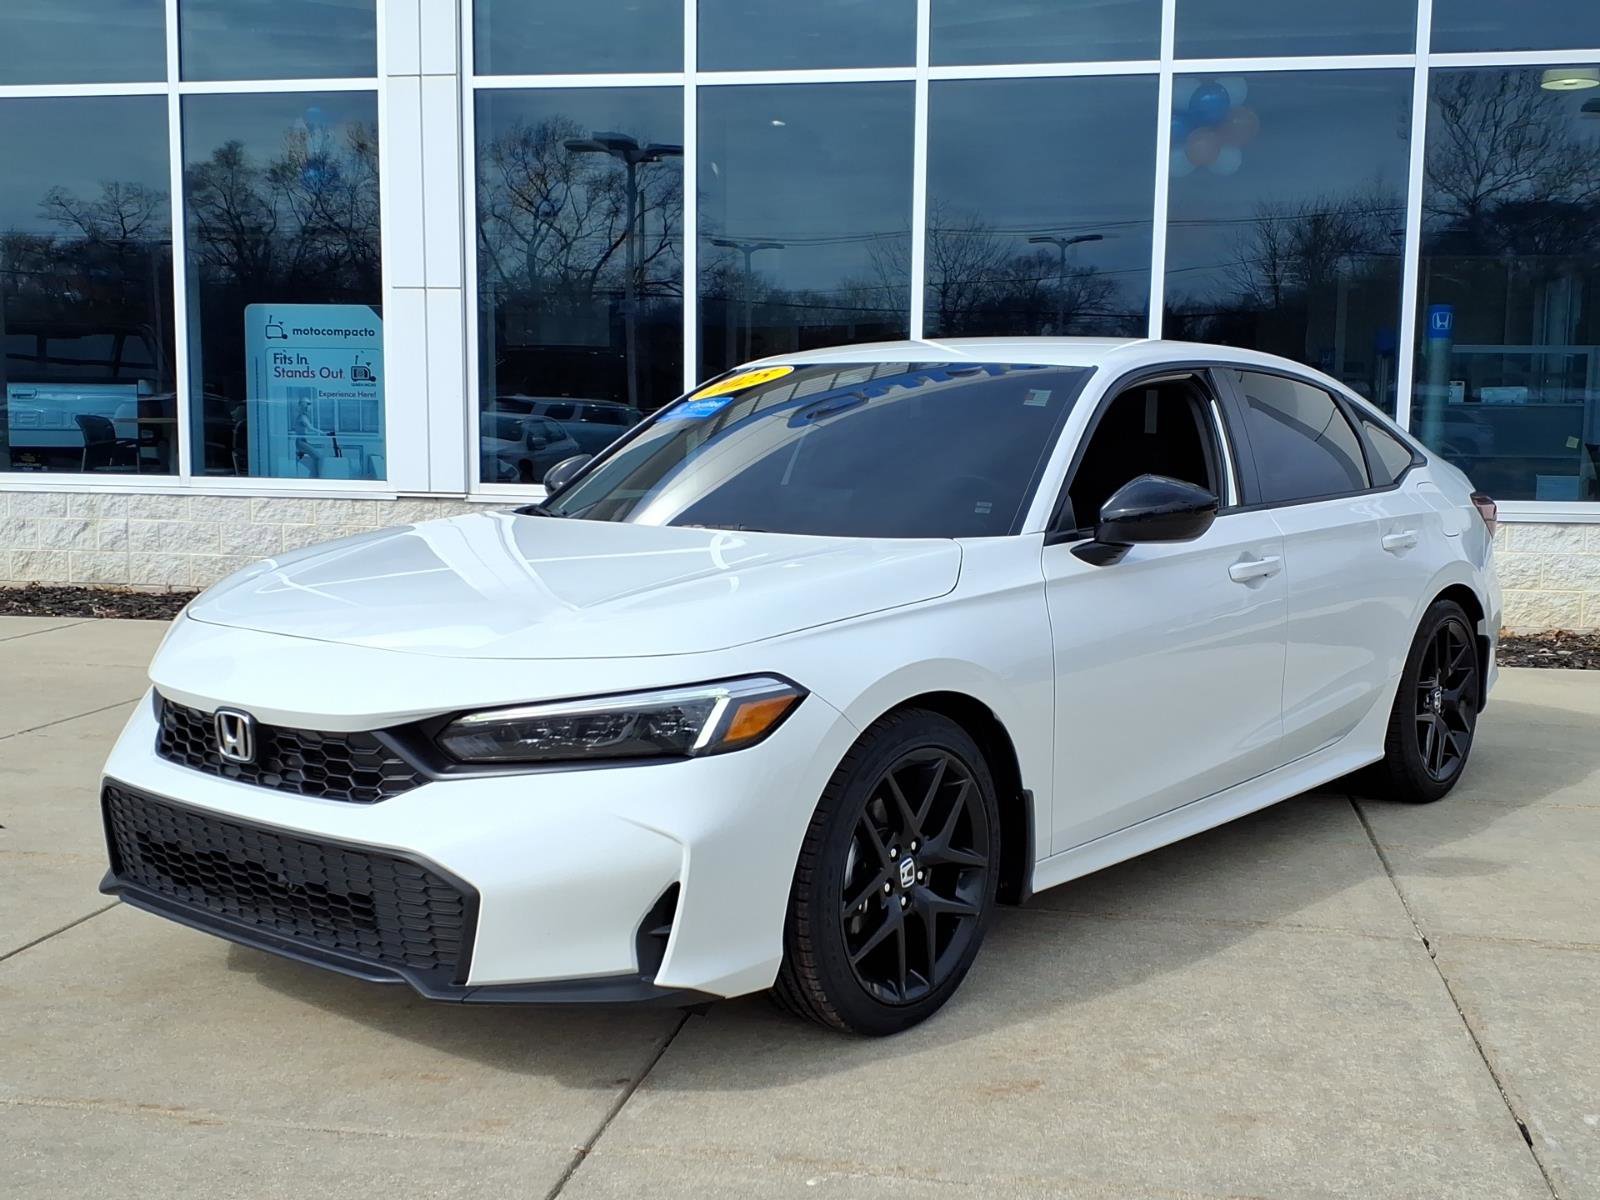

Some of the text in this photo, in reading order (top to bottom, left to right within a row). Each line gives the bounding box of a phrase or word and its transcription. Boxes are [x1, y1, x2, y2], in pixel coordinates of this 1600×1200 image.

[292, 327, 376, 339] motocompacto
[273, 352, 293, 365] Fits
[273, 366, 316, 379] Stands
[318, 390, 356, 399] Experience
